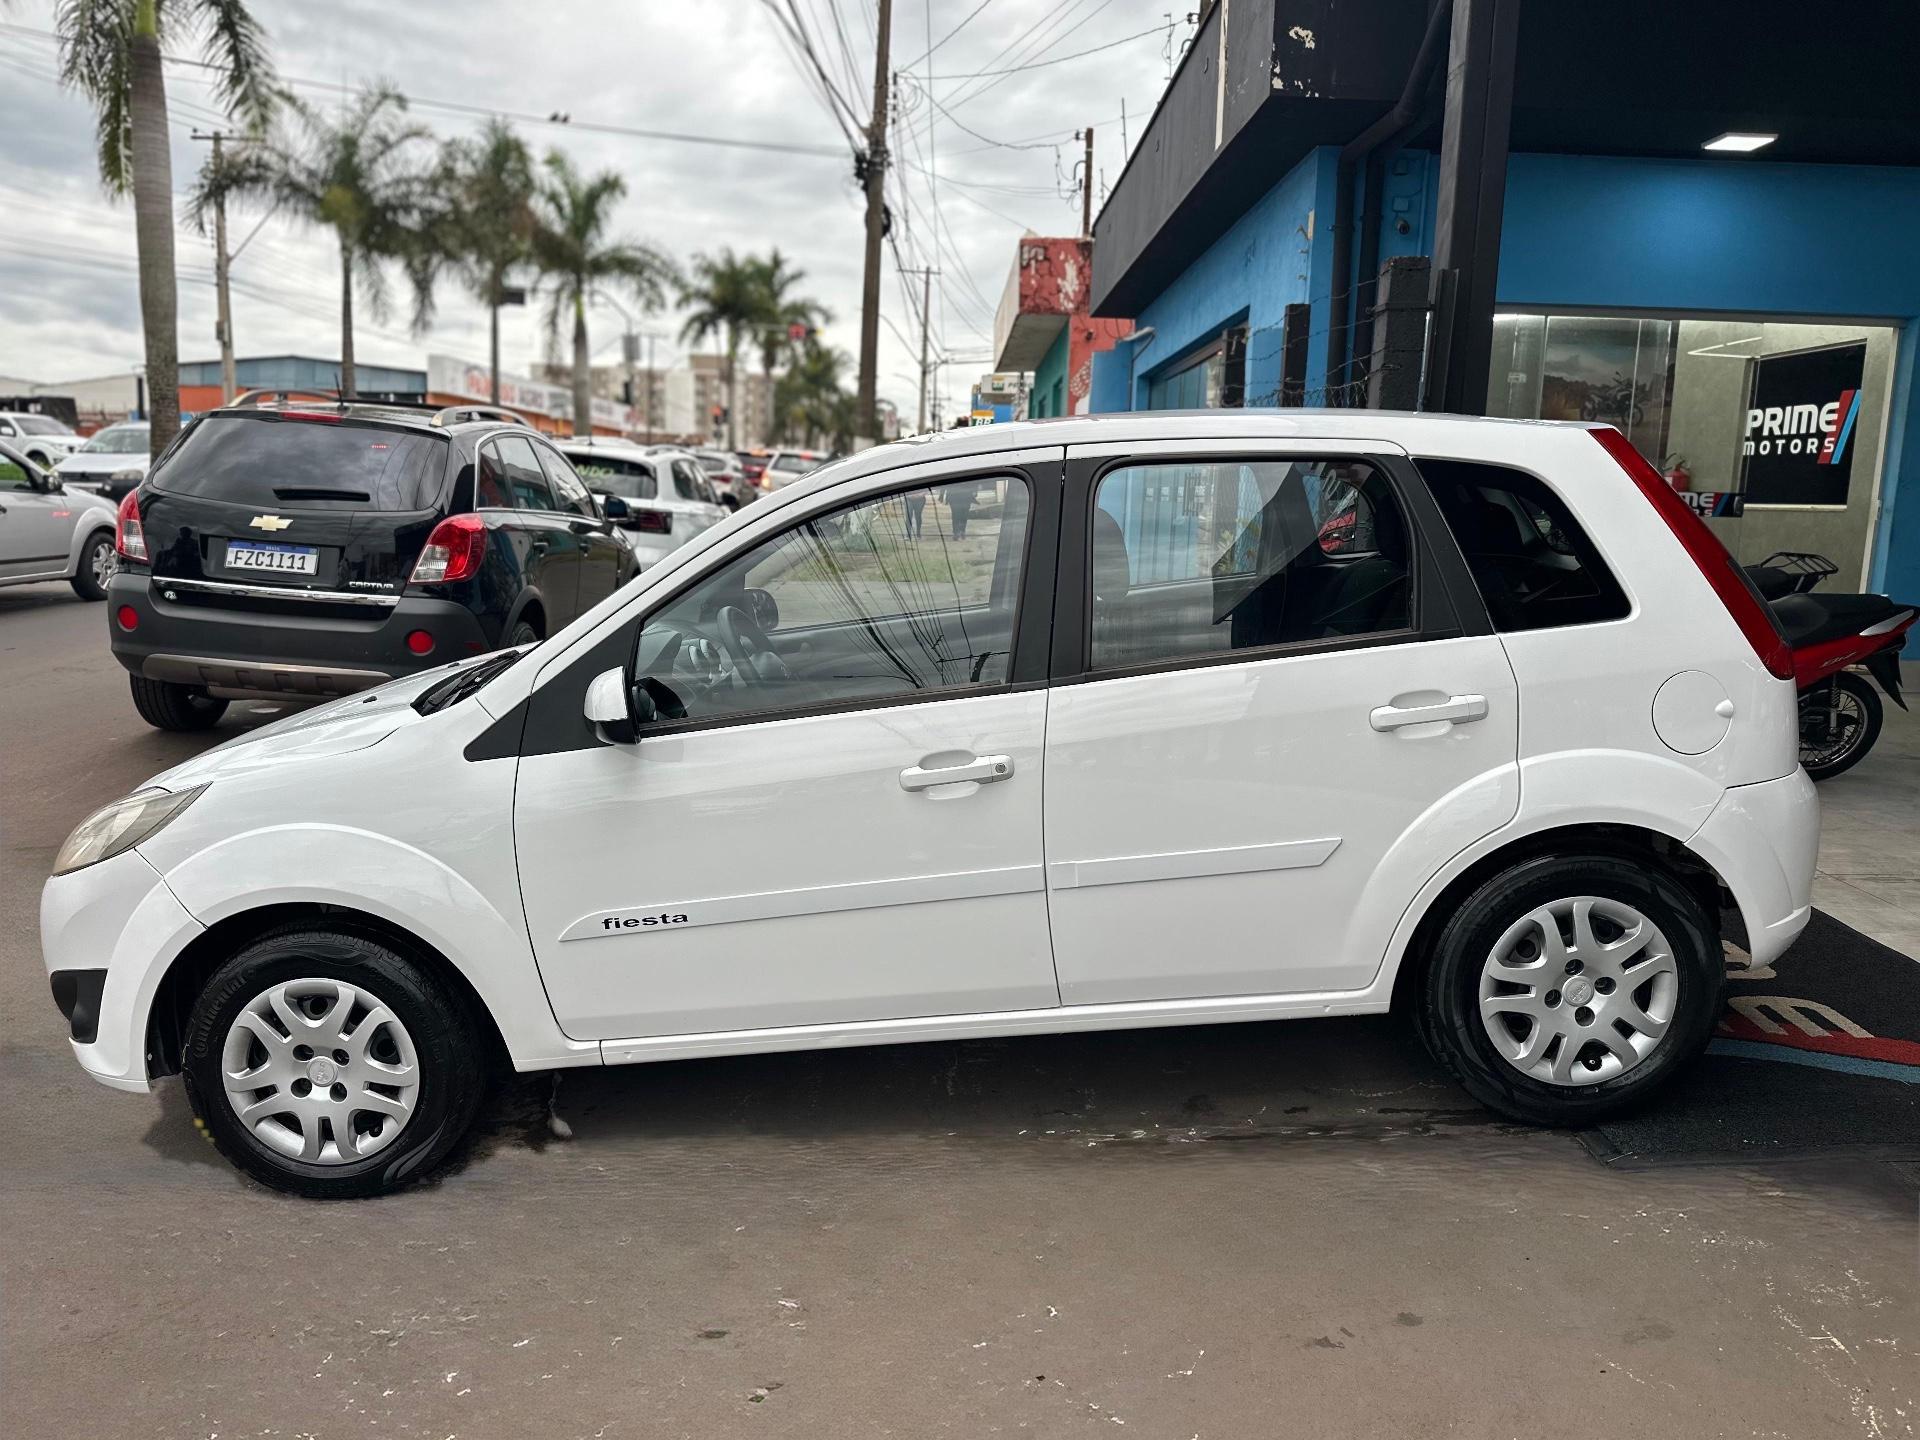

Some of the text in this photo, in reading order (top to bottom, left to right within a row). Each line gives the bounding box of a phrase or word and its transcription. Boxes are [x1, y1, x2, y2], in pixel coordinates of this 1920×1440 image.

[1744, 401, 1840, 436] PRIME
[1742, 437, 1836, 456] MOTORS
[575, 464, 615, 478] NDO
[233, 549, 306, 571] FZC1I11
[348, 581, 394, 589] CAPTIVA
[601, 912, 689, 930] fiesta
